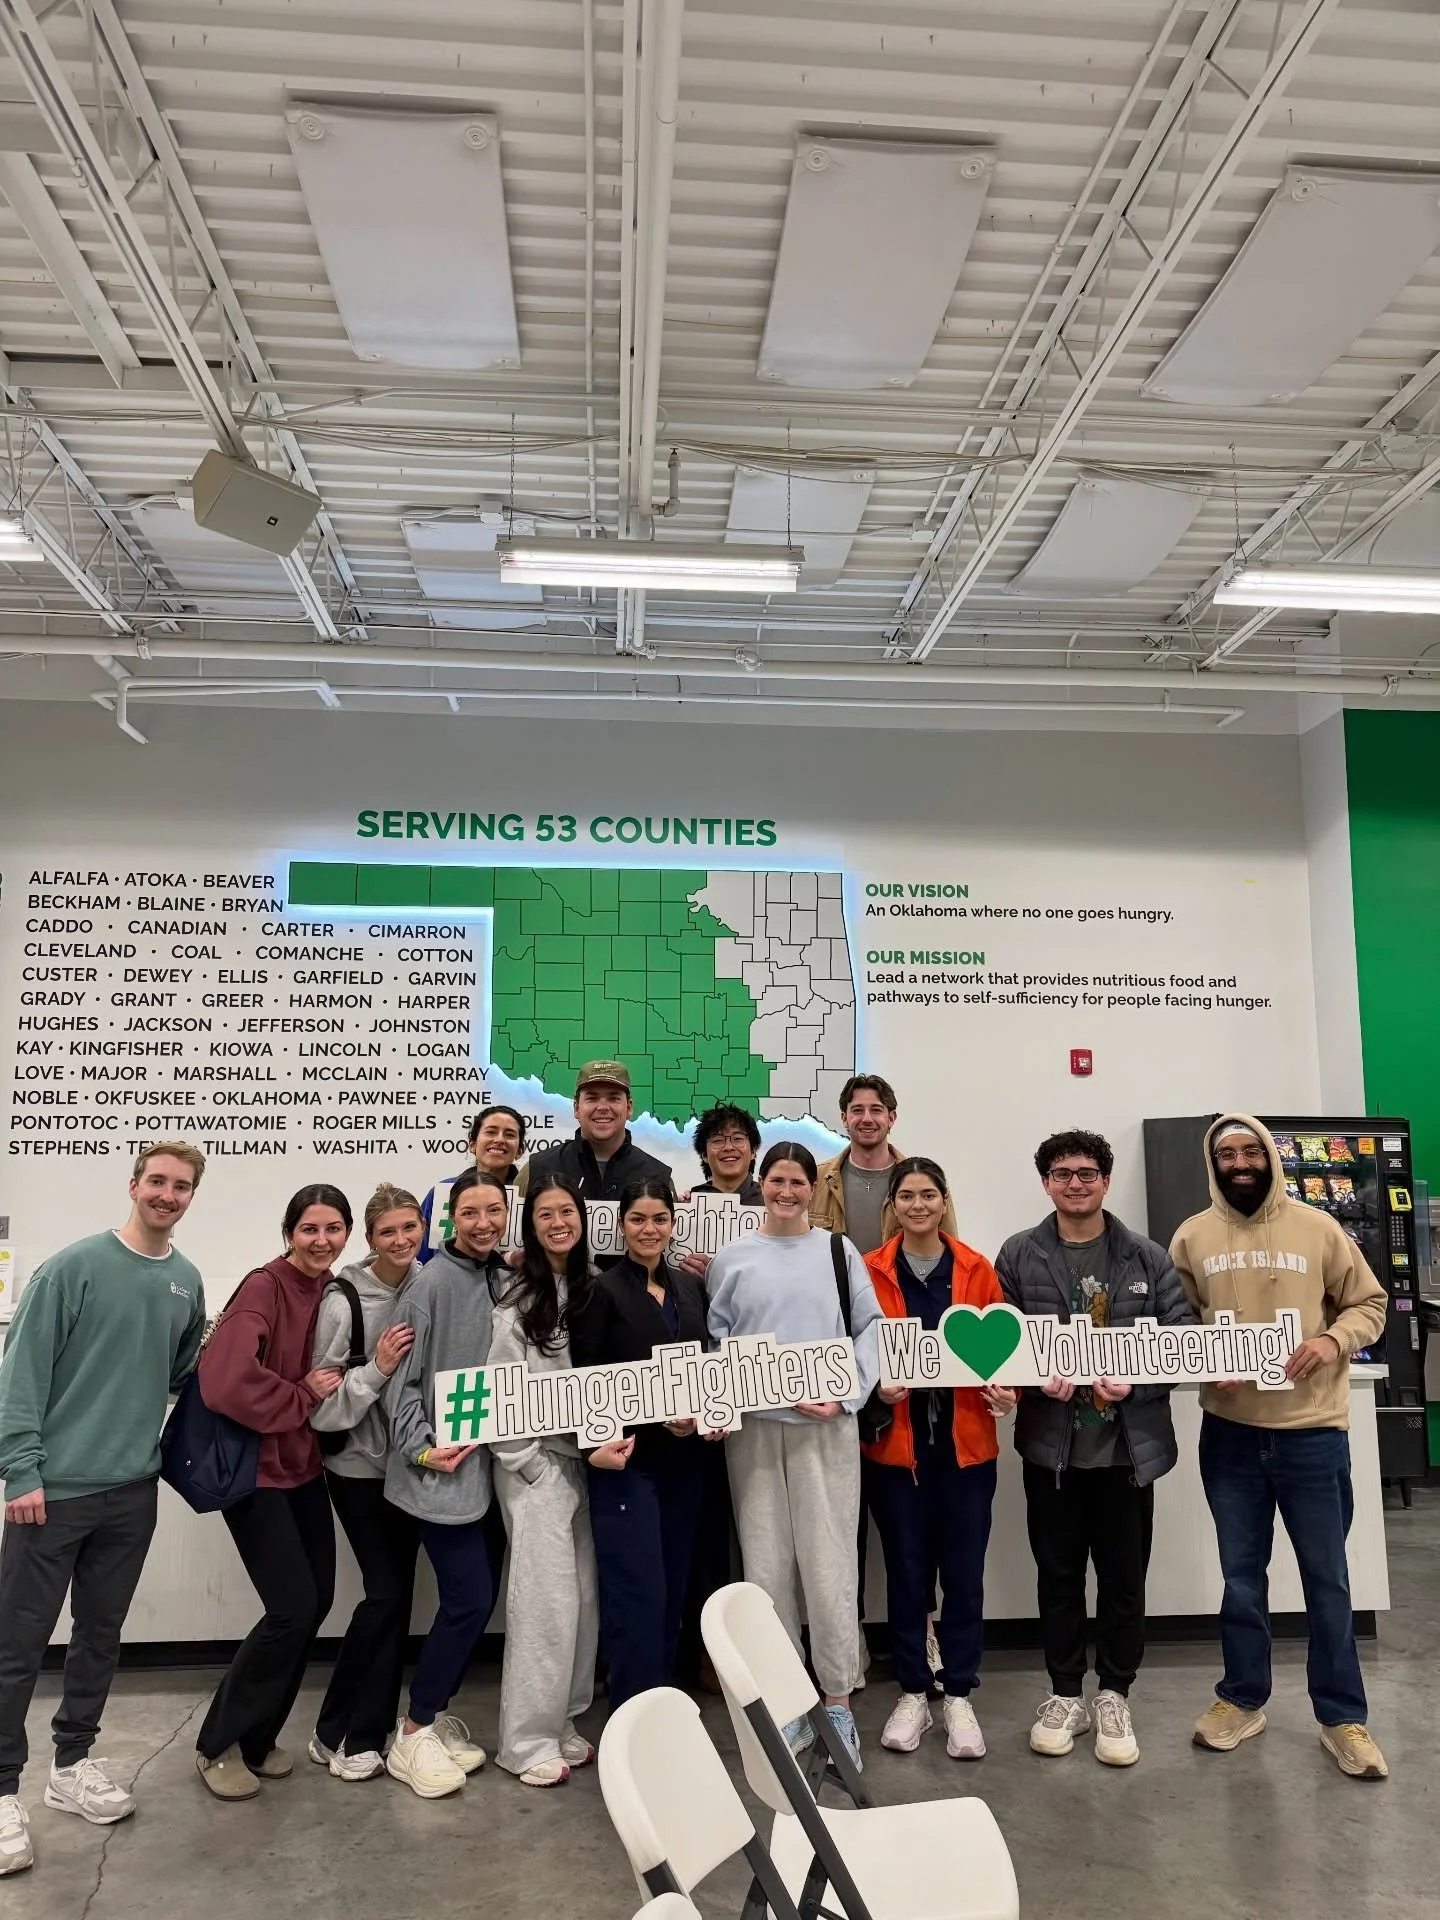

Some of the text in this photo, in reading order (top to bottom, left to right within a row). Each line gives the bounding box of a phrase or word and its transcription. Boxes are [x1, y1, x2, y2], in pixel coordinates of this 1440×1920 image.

[356, 809, 778, 848] SERVING 53 COUNTIES
[29, 871, 275, 888] ALFALFA ATOKA BEAVER
[866, 884, 968, 898] OUR VISION
[28, 895, 284, 912] BECKHAM BLAINE BRYAN
[866, 904, 1174, 923] An Oklahoma where no one goes hungry.
[26, 919, 466, 939] CADDO CANADIAN CARTER CIMARRON
[24, 943, 473, 962] CLEVELAND COAL COMANCHE COTTON
[867, 951, 985, 964] OUR MISSION
[23, 967, 476, 985] CUSTER DEWEY ELLIS GARFIELD GARVIN
[868, 971, 1236, 988] Lead a network that provides nutritious food and
[21, 992, 470, 1009] GRADY GRANT GREER HARMON HARPER
[867, 990, 1272, 1010] pathways to self-sufficiency for people facing hunger.
[18, 1017, 470, 1033] HUGHES JACKSON JEFFERSON JOHNSTON
[16, 1041, 470, 1056] KAY KINGFISHER KIOWA LINCOLN LOGAN
[14, 1066, 489, 1080] LOVE MAJOR MARSHALL MCCLAIN MURRAY
[12, 1091, 491, 1105] NOBLE OKFUSKEE OKLAHOMA PAWNEE PAYNE
[10, 1116, 118, 1130] PONTOTOC
[135, 1116, 286, 1130] POTTAWATOMIE
[313, 1116, 376, 1129] ROGER
[383, 1116, 436, 1129] MILLS
[9, 1141, 109, 1155] STEPHENS
[203, 1141, 286, 1154] TILLMAN
[313, 1140, 397, 1154] WASHITA
[1203, 1249, 1307, 1277] BLOCK ISLAND
[882, 1314, 1295, 1385] We Volunteering!
[445, 1341, 852, 1442] #HungerFighters
